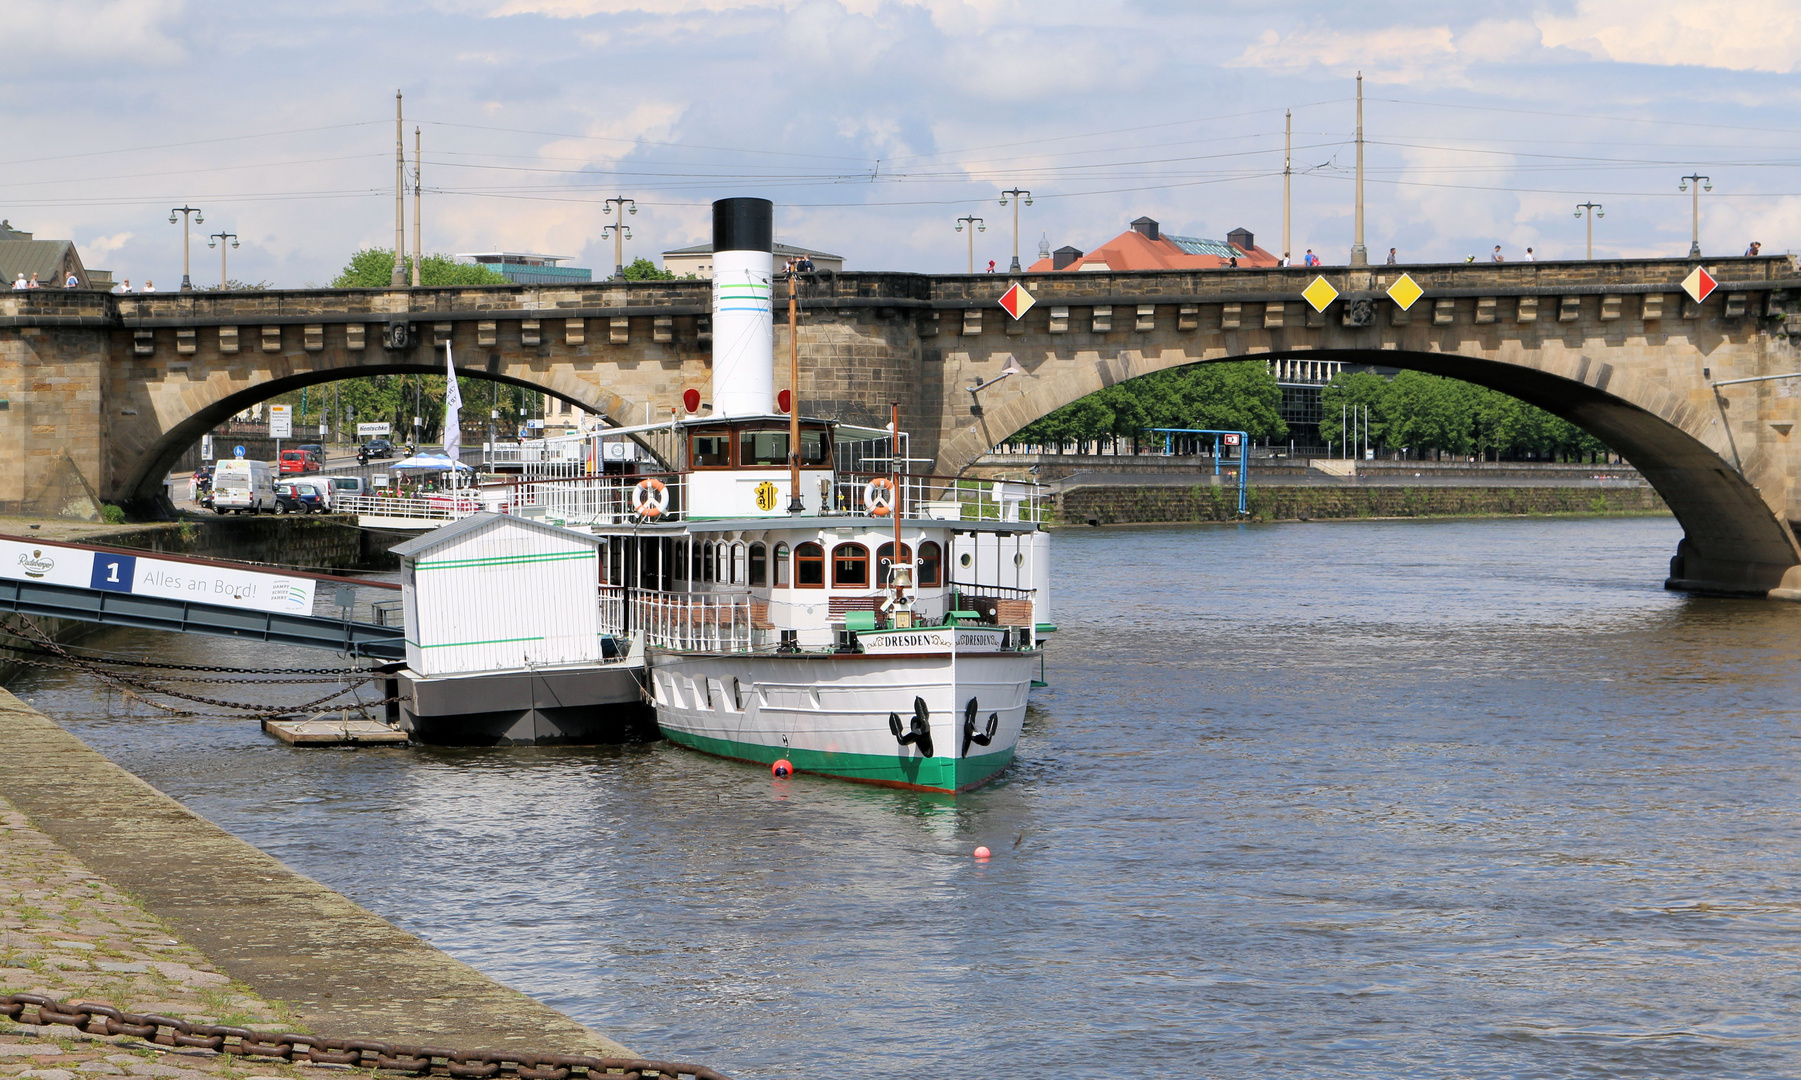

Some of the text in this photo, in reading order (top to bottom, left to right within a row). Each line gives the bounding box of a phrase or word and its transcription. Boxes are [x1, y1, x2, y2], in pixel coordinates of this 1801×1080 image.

[17, 553, 54, 573] Radeberger
[106, 562, 120, 583] 1
[143, 571, 257, 598] Alles an Bord!
[885, 635, 931, 647] DRESDEN
[965, 634, 991, 646] DRESDEN
